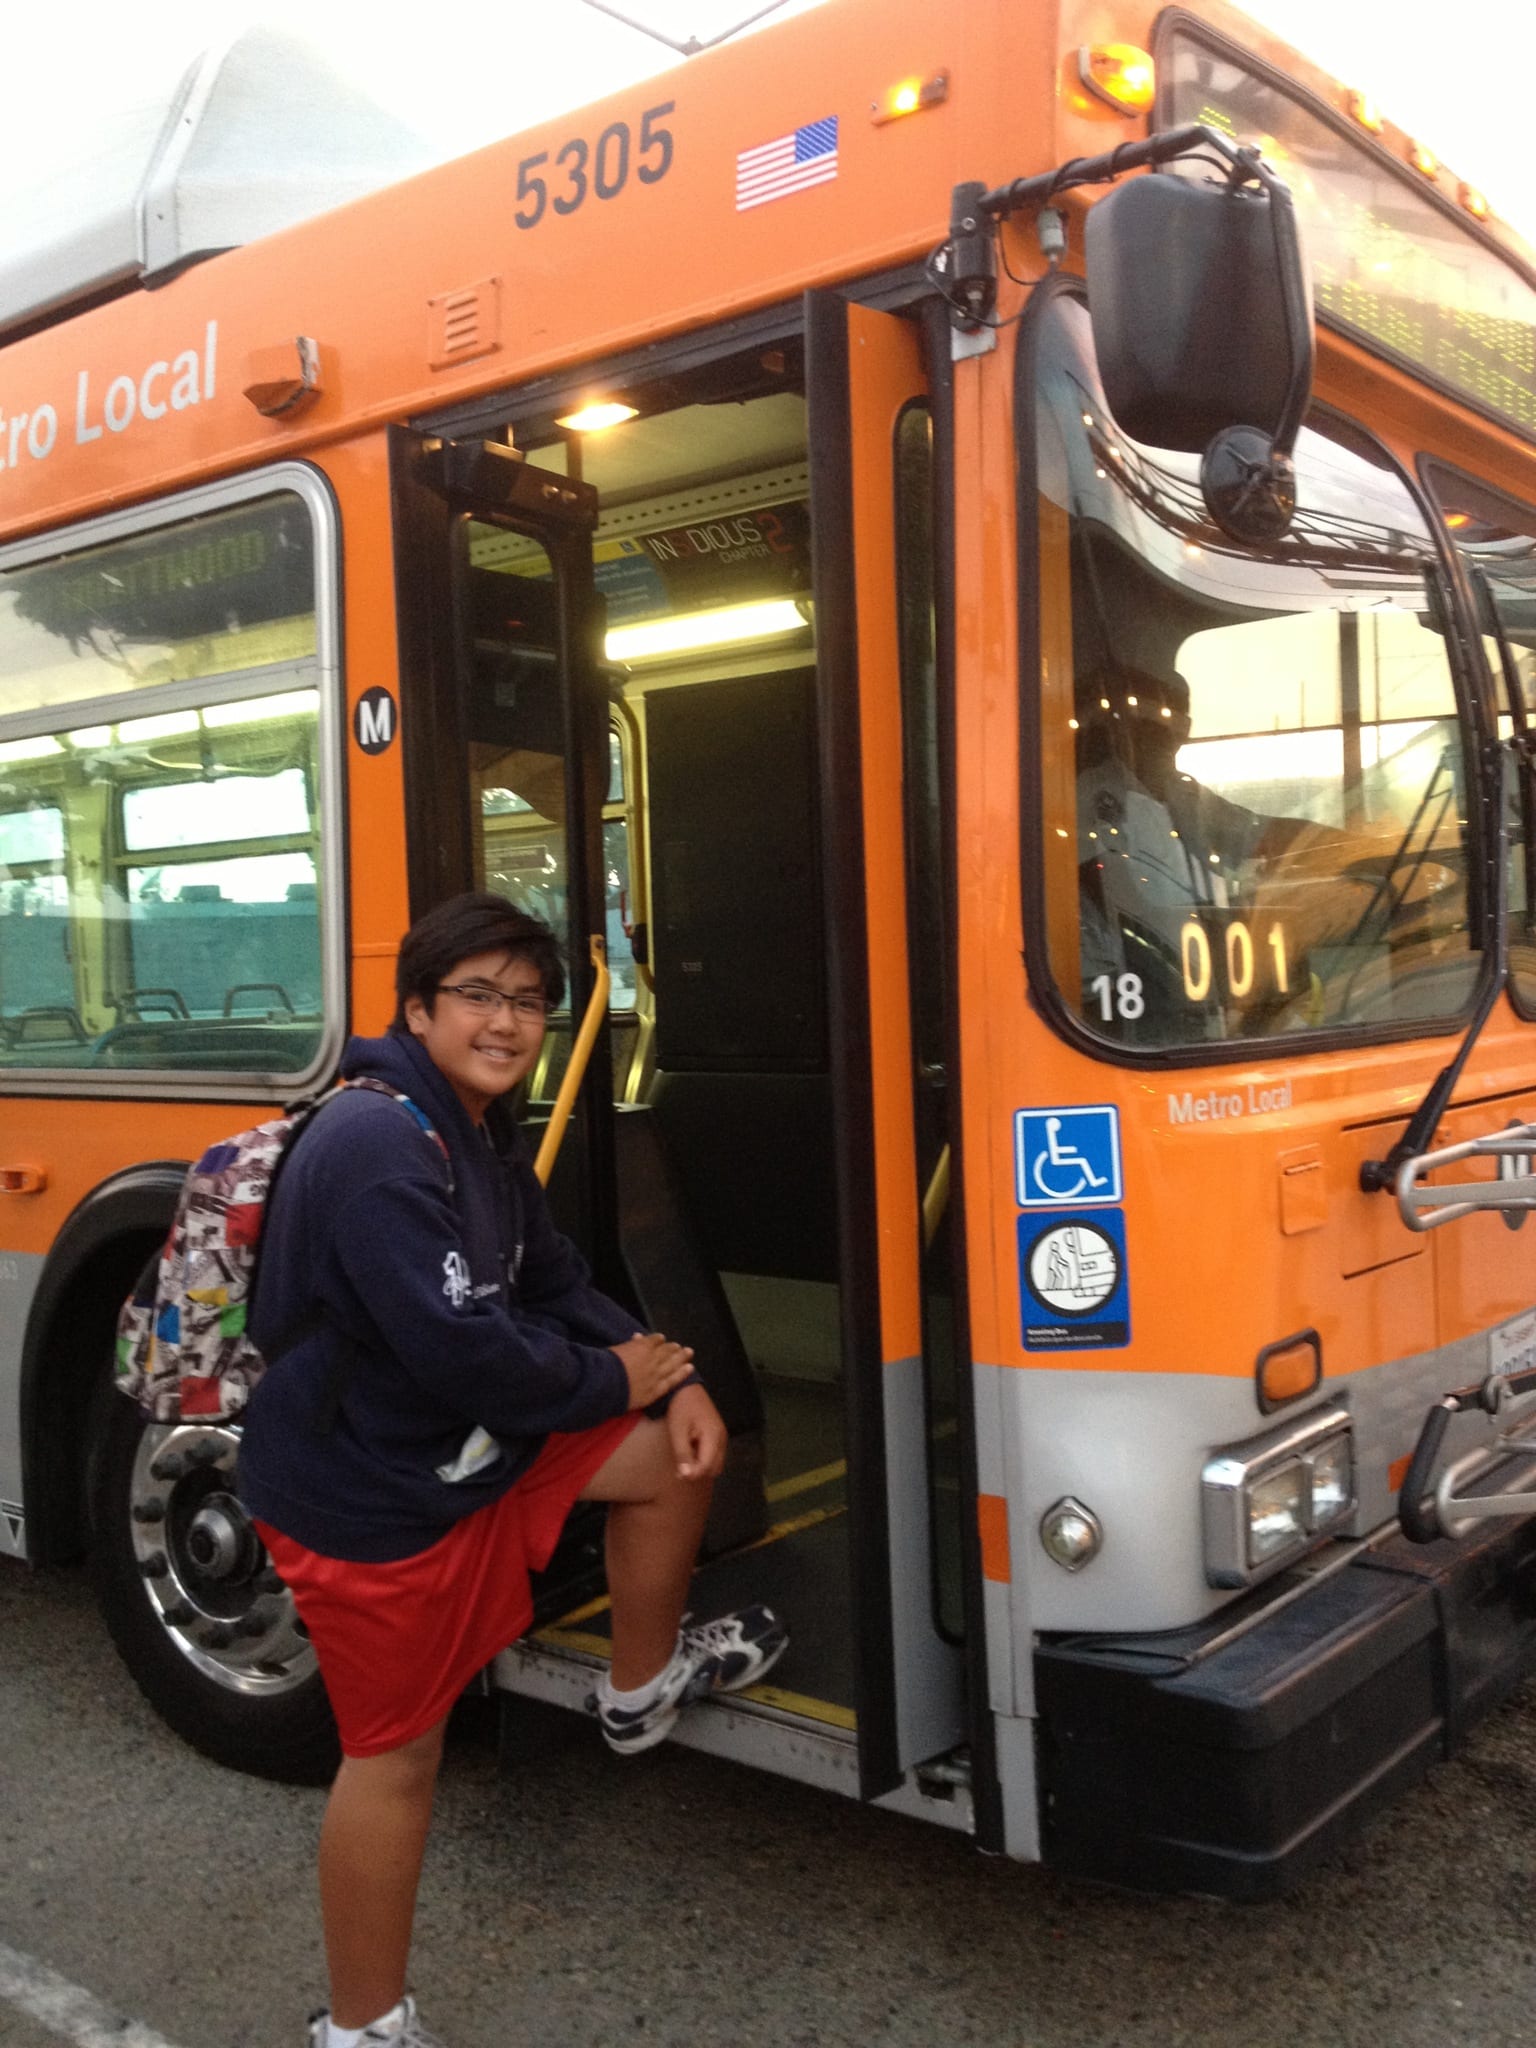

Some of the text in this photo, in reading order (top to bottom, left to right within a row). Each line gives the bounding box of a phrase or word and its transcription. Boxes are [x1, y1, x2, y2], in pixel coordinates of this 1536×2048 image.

[514, 99, 676, 230] 5305
[75, 319, 218, 446] Local
[756, 511, 793, 553] 2
[359, 696, 391, 746] M
[1180, 921, 1289, 1001] 001
[1091, 972, 1145, 1022] 18
[1167, 1078, 1293, 1125] Metro Local
